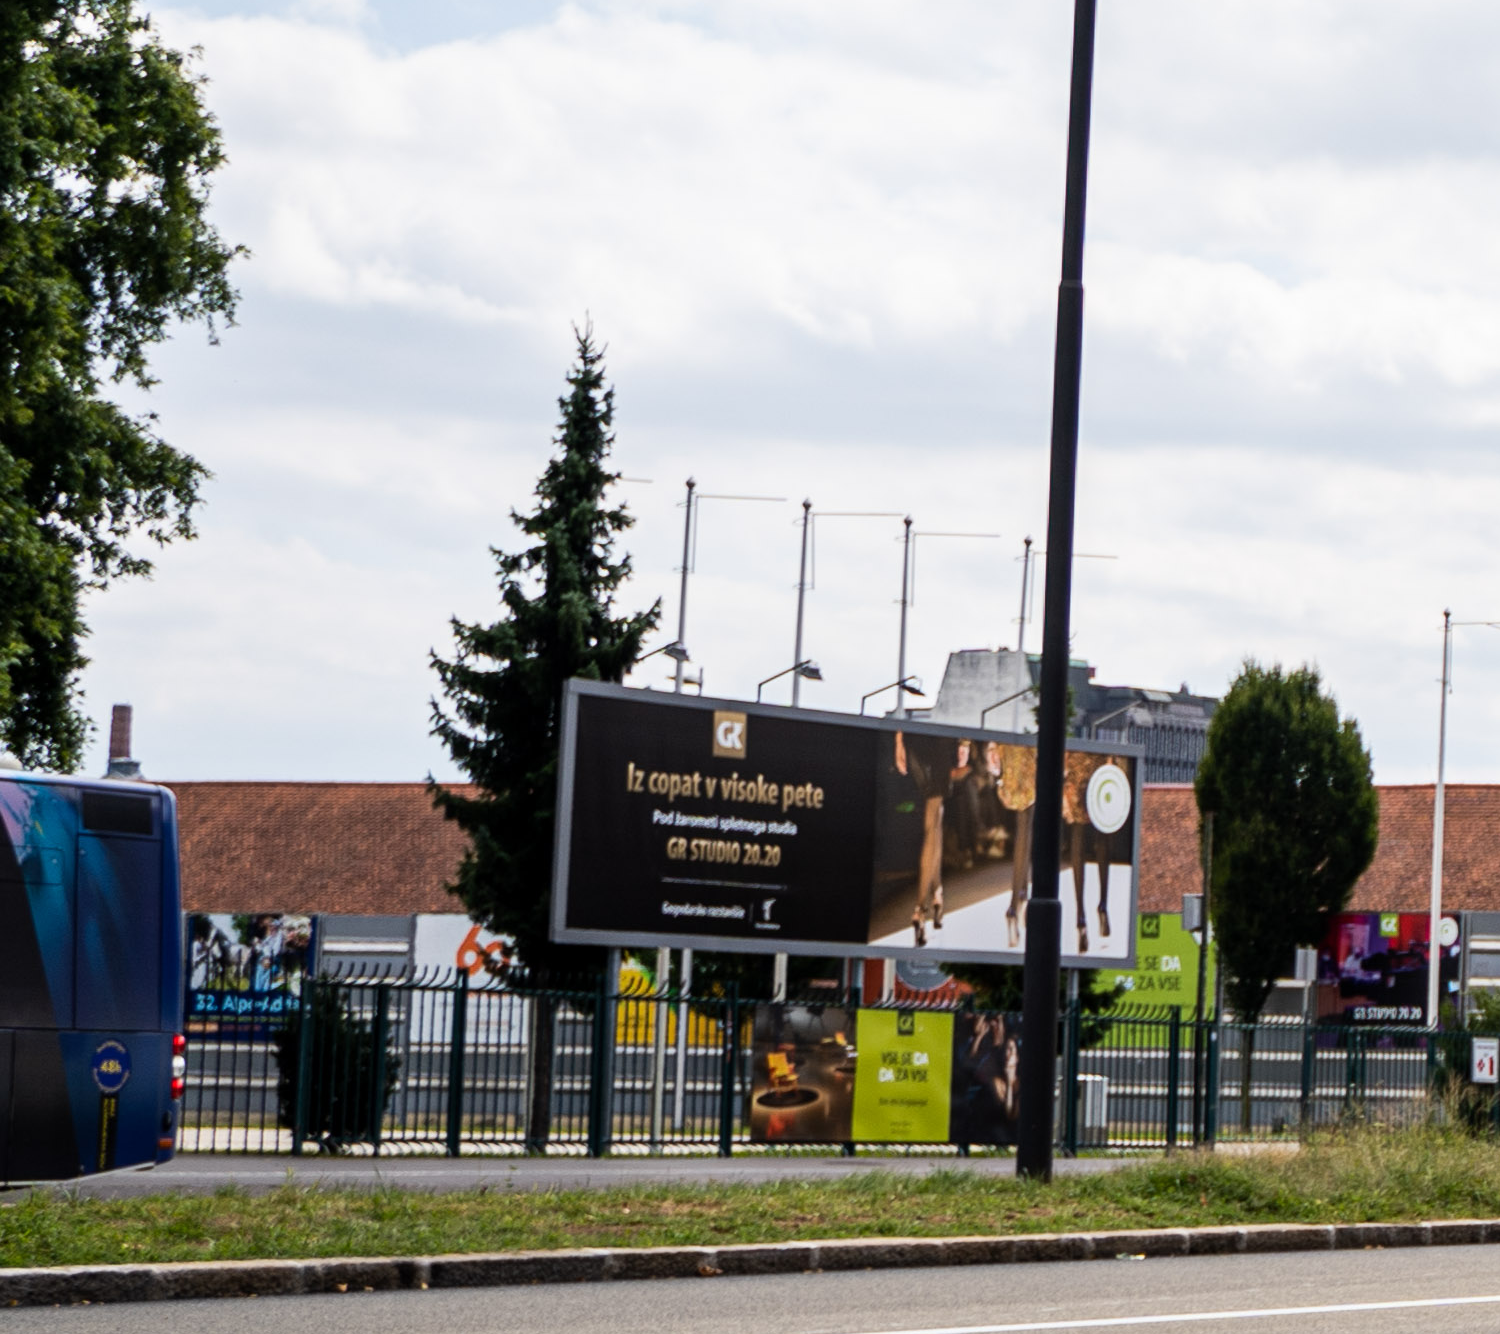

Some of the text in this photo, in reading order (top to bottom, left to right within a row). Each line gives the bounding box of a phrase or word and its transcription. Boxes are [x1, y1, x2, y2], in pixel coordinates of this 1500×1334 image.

[626, 761, 824, 813] Iz copat v visoke pete
[652, 808, 675, 826] Pod
[667, 836, 781, 867] GR STUDIO 20.20
[1160, 955, 1181, 972] DA
